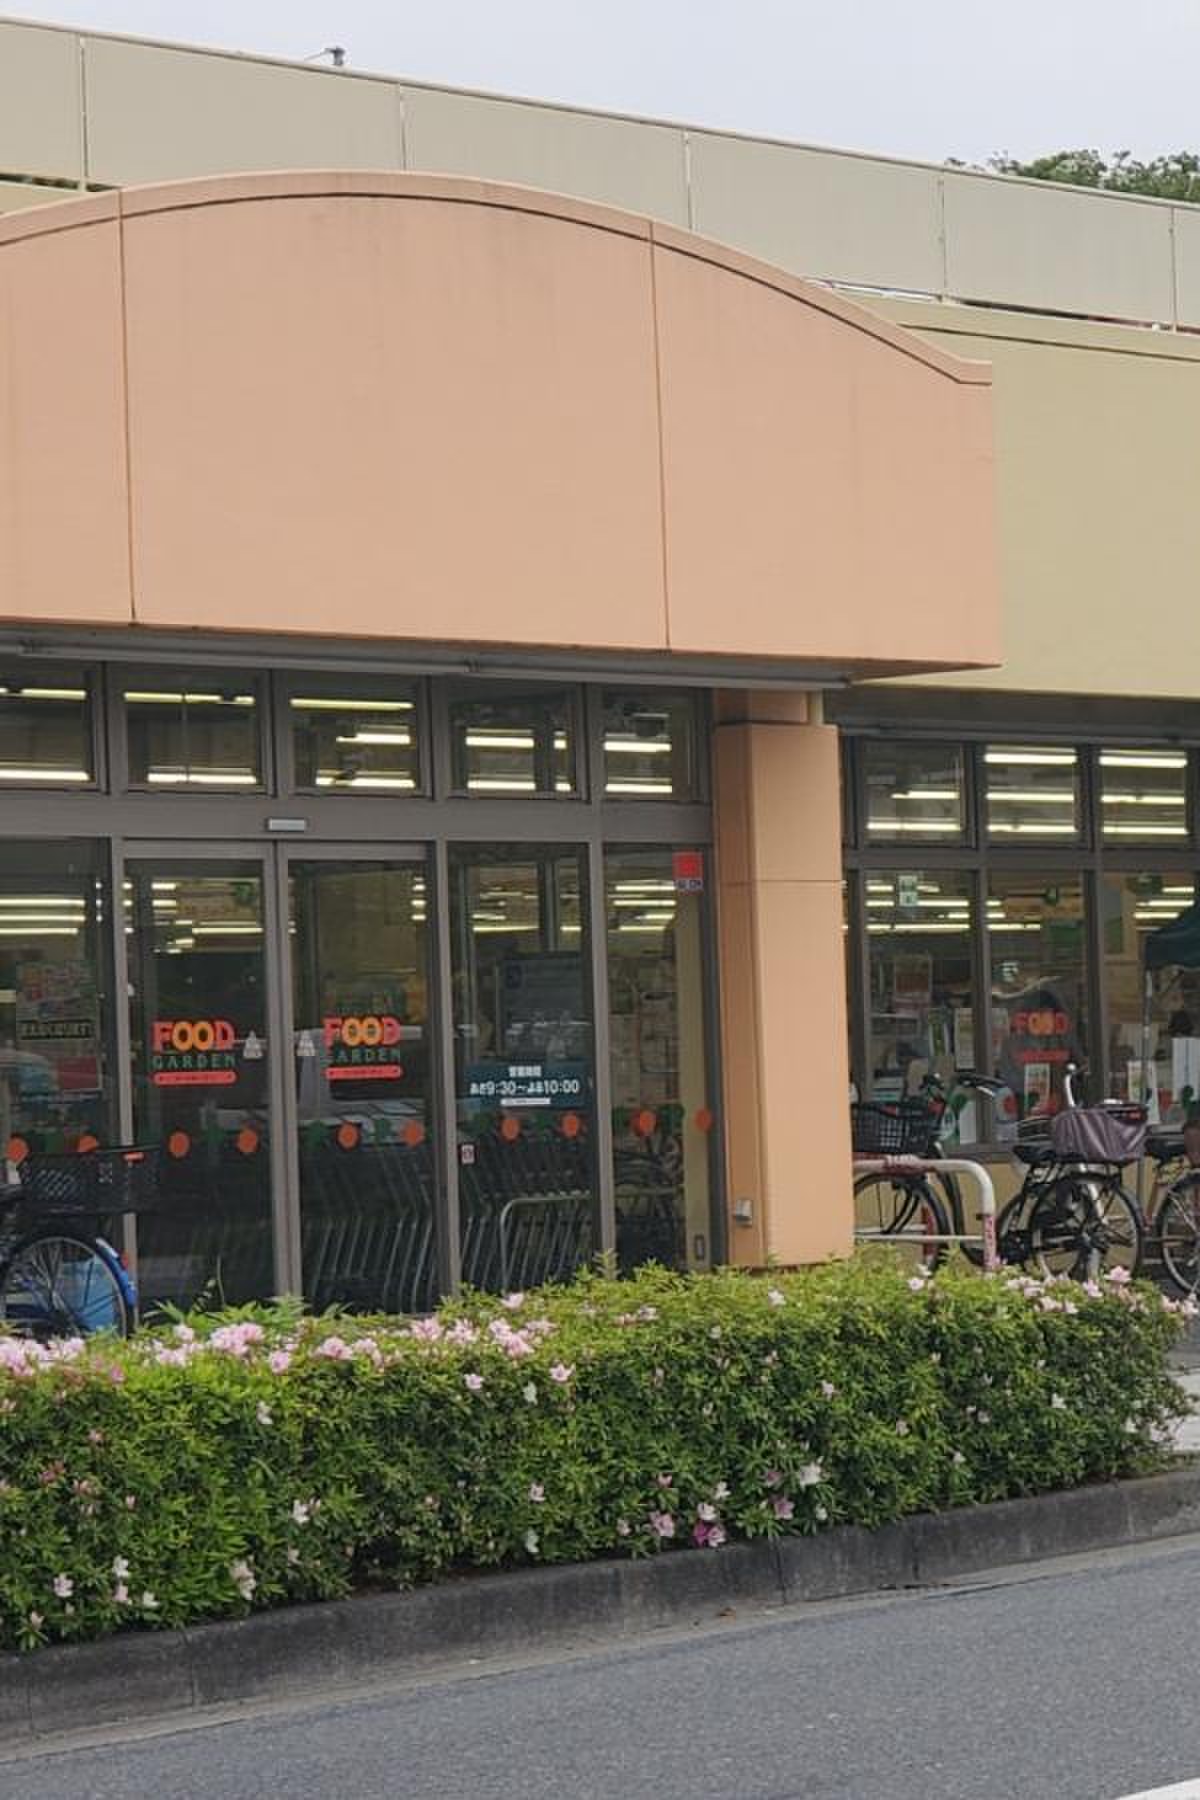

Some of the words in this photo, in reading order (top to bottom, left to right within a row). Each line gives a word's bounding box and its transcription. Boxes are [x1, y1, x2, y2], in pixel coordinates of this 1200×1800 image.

[153, 1020, 235, 1052] FOOD
[323, 1016, 401, 1051] FOOD
[152, 1055, 236, 1069] GARDEN
